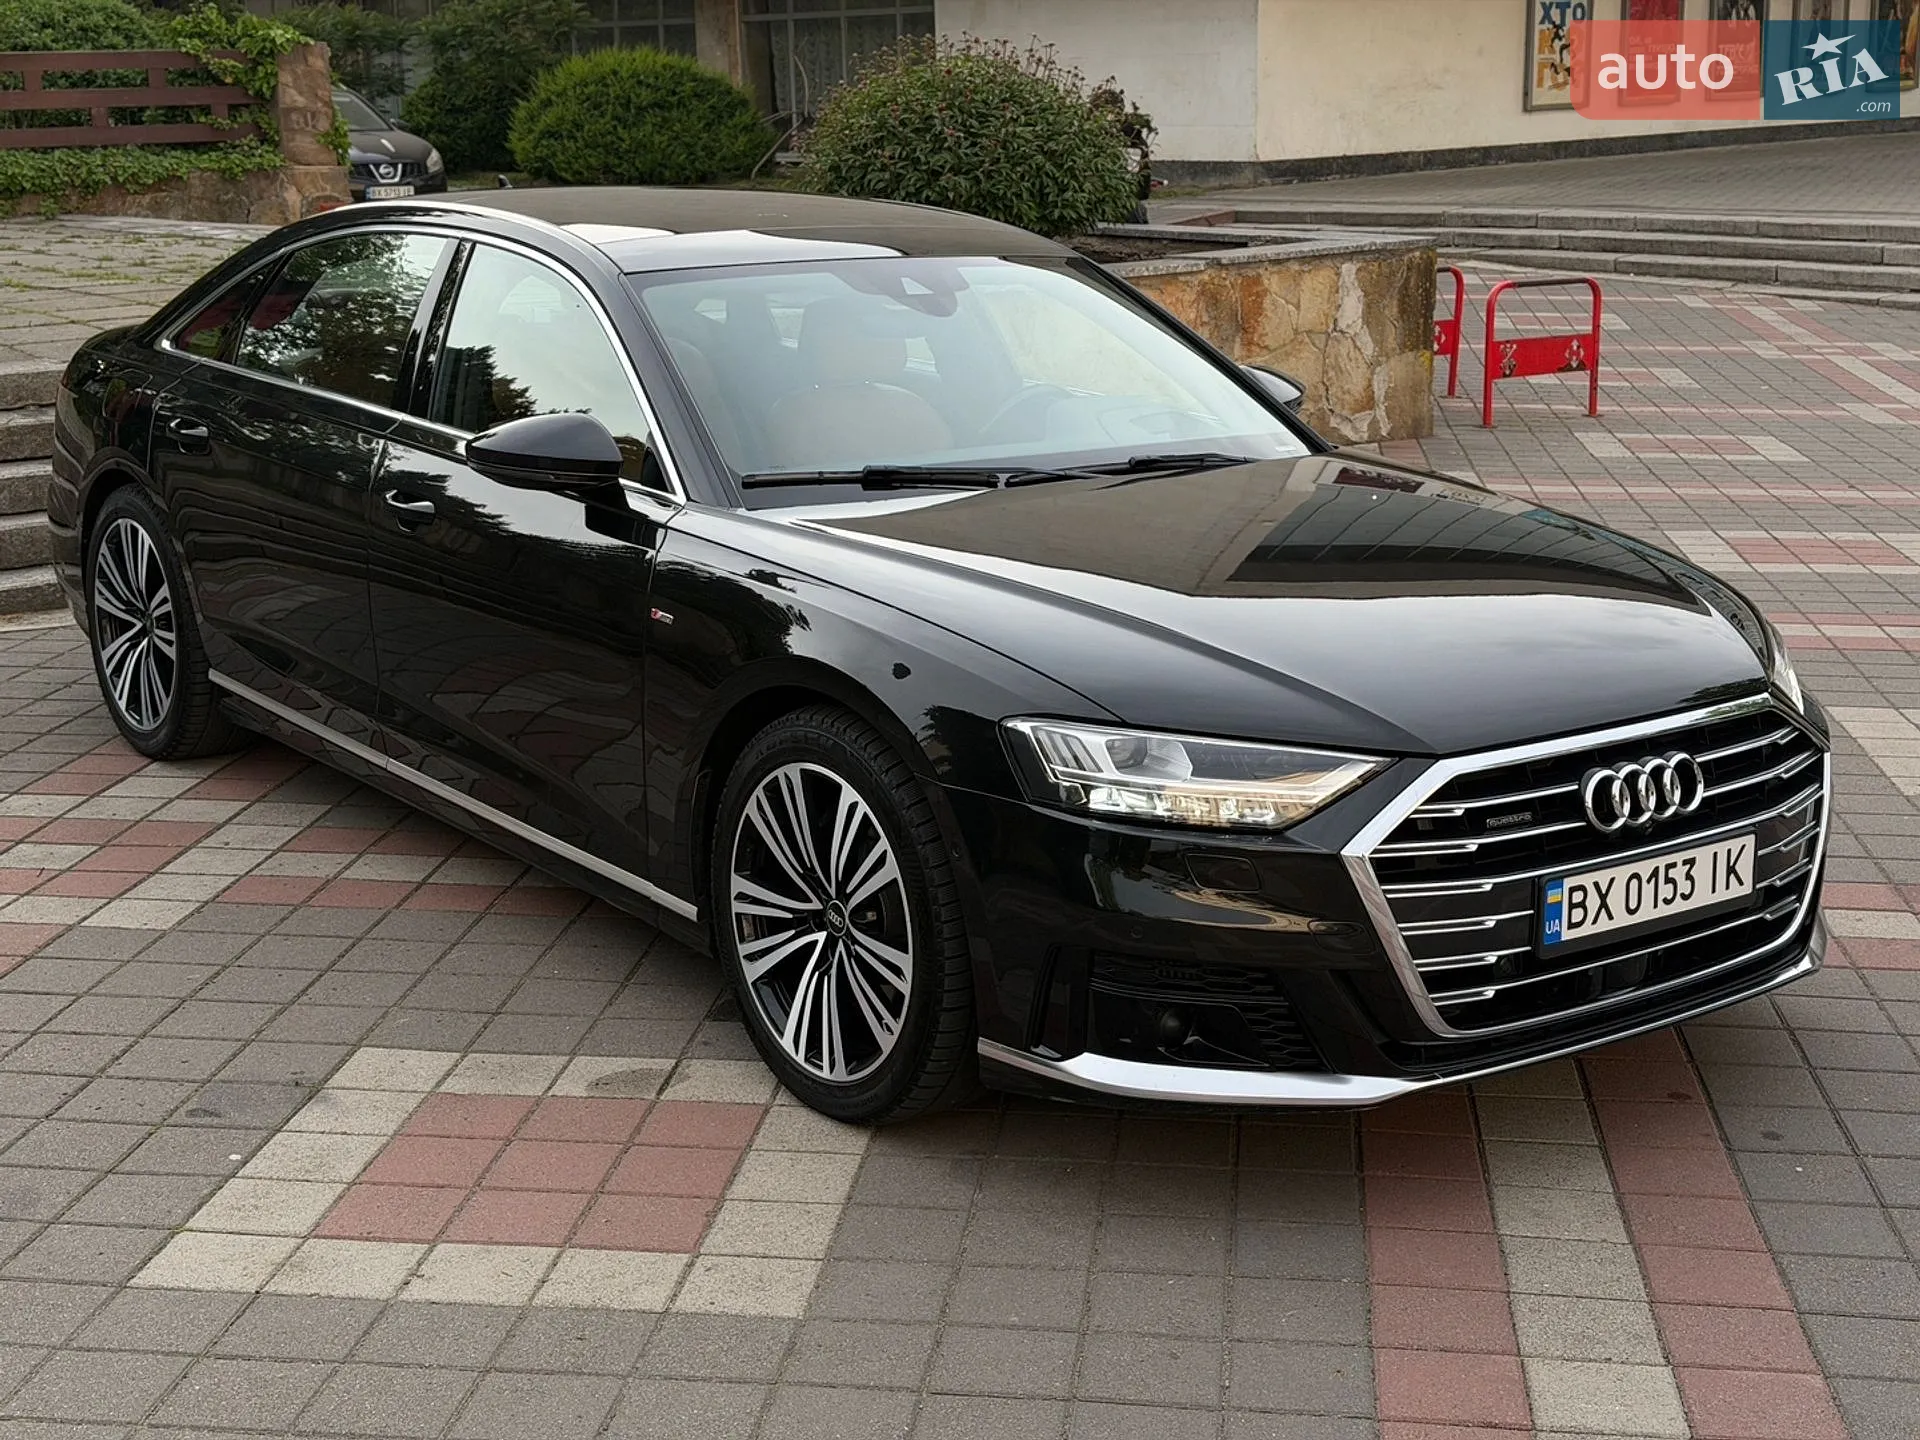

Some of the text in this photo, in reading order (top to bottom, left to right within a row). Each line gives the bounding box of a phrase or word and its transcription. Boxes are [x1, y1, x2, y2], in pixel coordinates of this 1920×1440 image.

[1567, 843, 1747, 930] BX 0153 IK
[1545, 919, 1561, 934] UA
